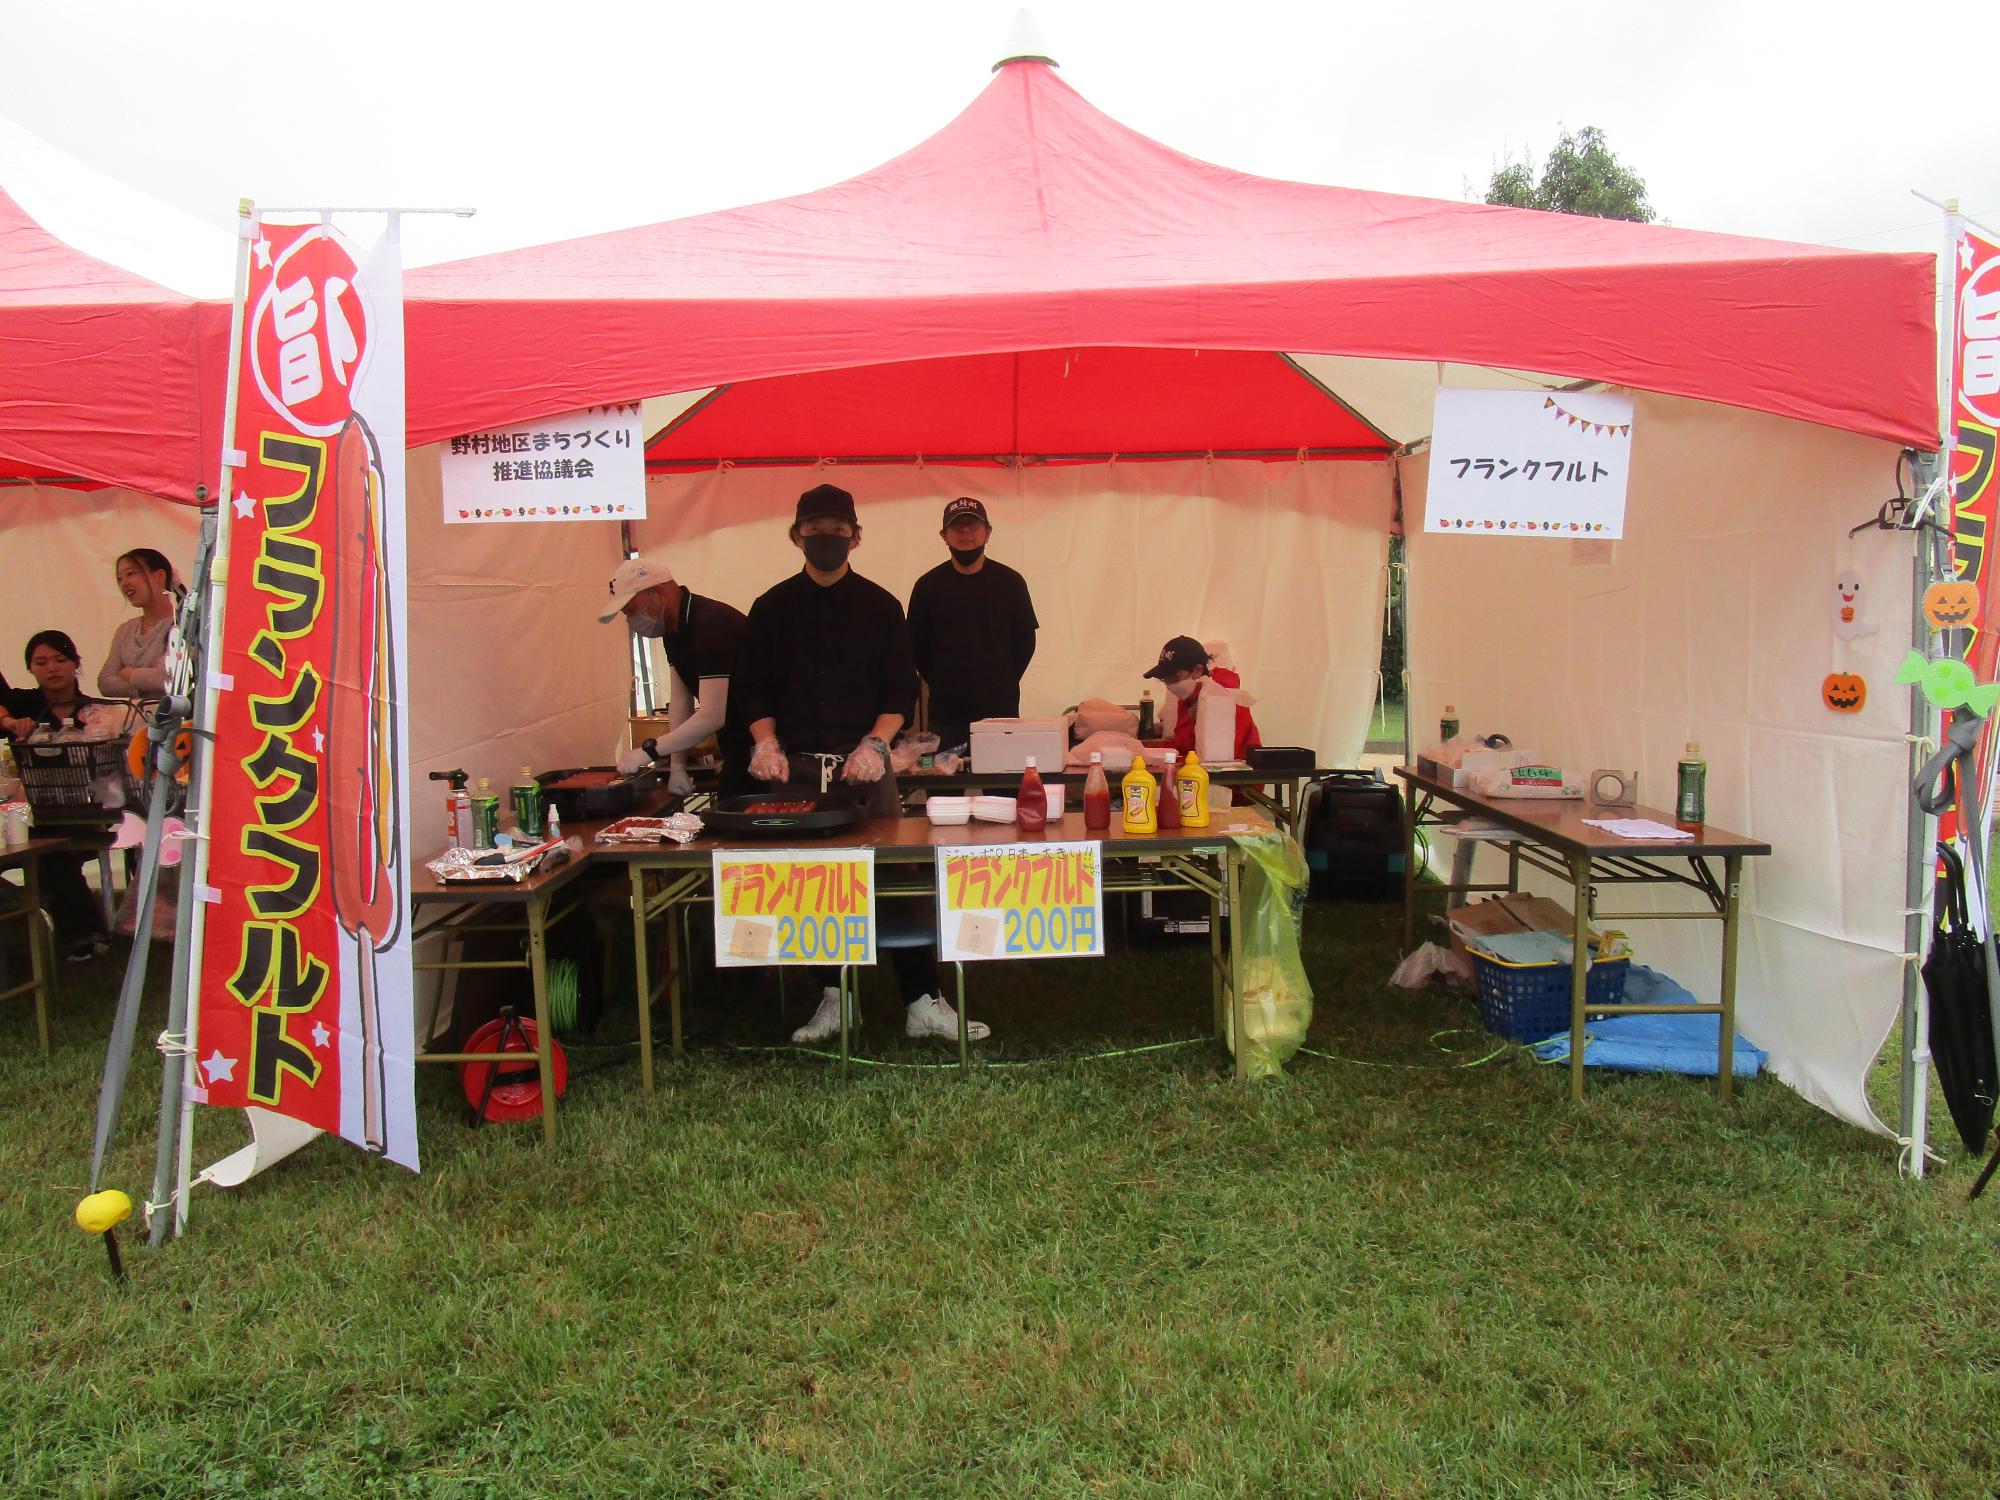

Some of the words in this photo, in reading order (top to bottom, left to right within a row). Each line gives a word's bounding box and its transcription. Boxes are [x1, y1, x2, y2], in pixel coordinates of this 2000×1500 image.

[451, 429, 630, 456] 野村地区まちづくり
[493, 458, 594, 482] 推進協議会
[1450, 458, 1609, 482] フランクフルト
[225, 430, 329, 1106] フランクフルト
[722, 863, 867, 913] フランクフルト
[947, 855, 1094, 909] フランクフルト
[778, 915, 869, 961] 200円
[1005, 906, 1096, 953] 200円
